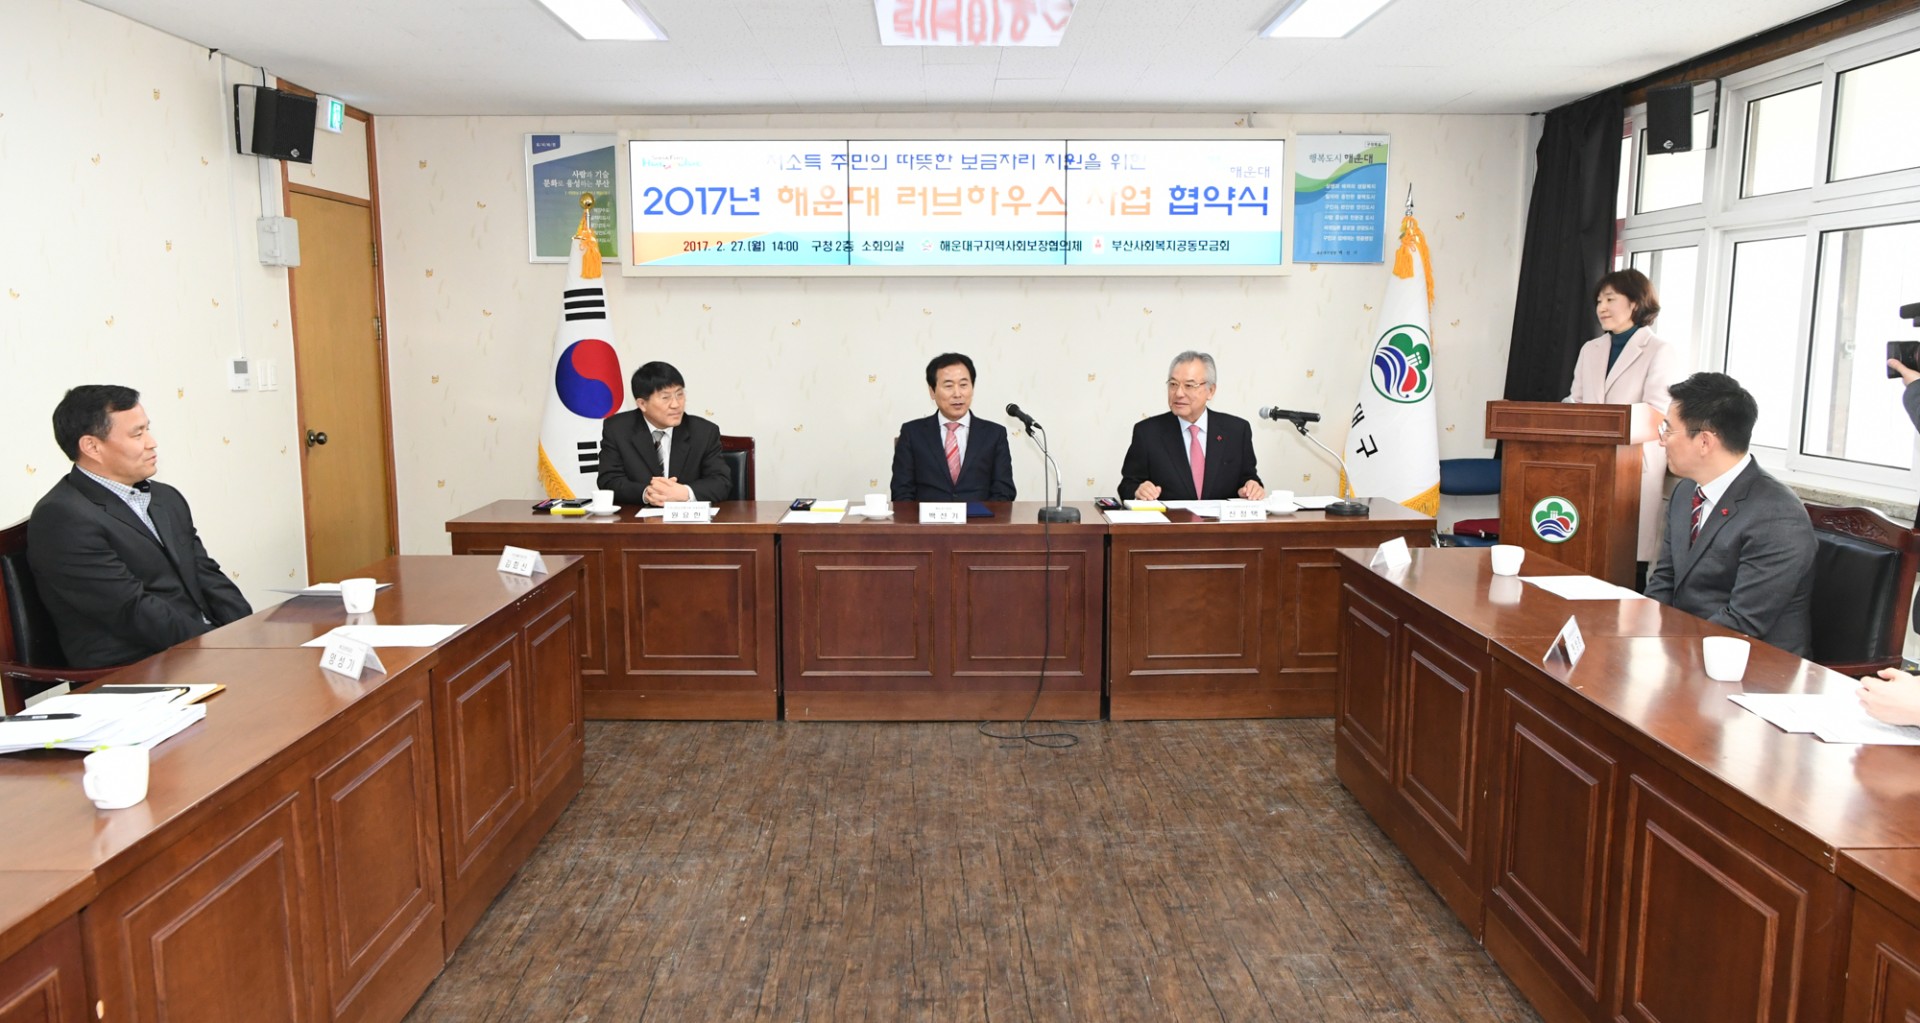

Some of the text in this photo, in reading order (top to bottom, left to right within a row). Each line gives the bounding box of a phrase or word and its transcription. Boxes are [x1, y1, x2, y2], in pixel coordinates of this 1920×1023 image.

[831, 154, 887, 171] 주민의
[896, 153, 953, 171] 따뜻한
[961, 153, 1035, 171] 보금자리
[1045, 153, 1102, 171] 지원을
[643, 186, 760, 216] 2017년
[777, 185, 880, 216] 해운대
[896, 184, 1067, 217] 러브하우스
[1168, 184, 1268, 216] 협약식
[683, 240, 710, 252] 2017.
[716, 240, 726, 252] 2.
[772, 240, 799, 252] 14:00
[811, 240, 833, 253] 구청
[861, 240, 904, 253] 소회의실
[940, 240, 1082, 252] 해운대구지역사회보장협의체
[1112, 240, 1230, 252] 부산사회복지공동모금회
